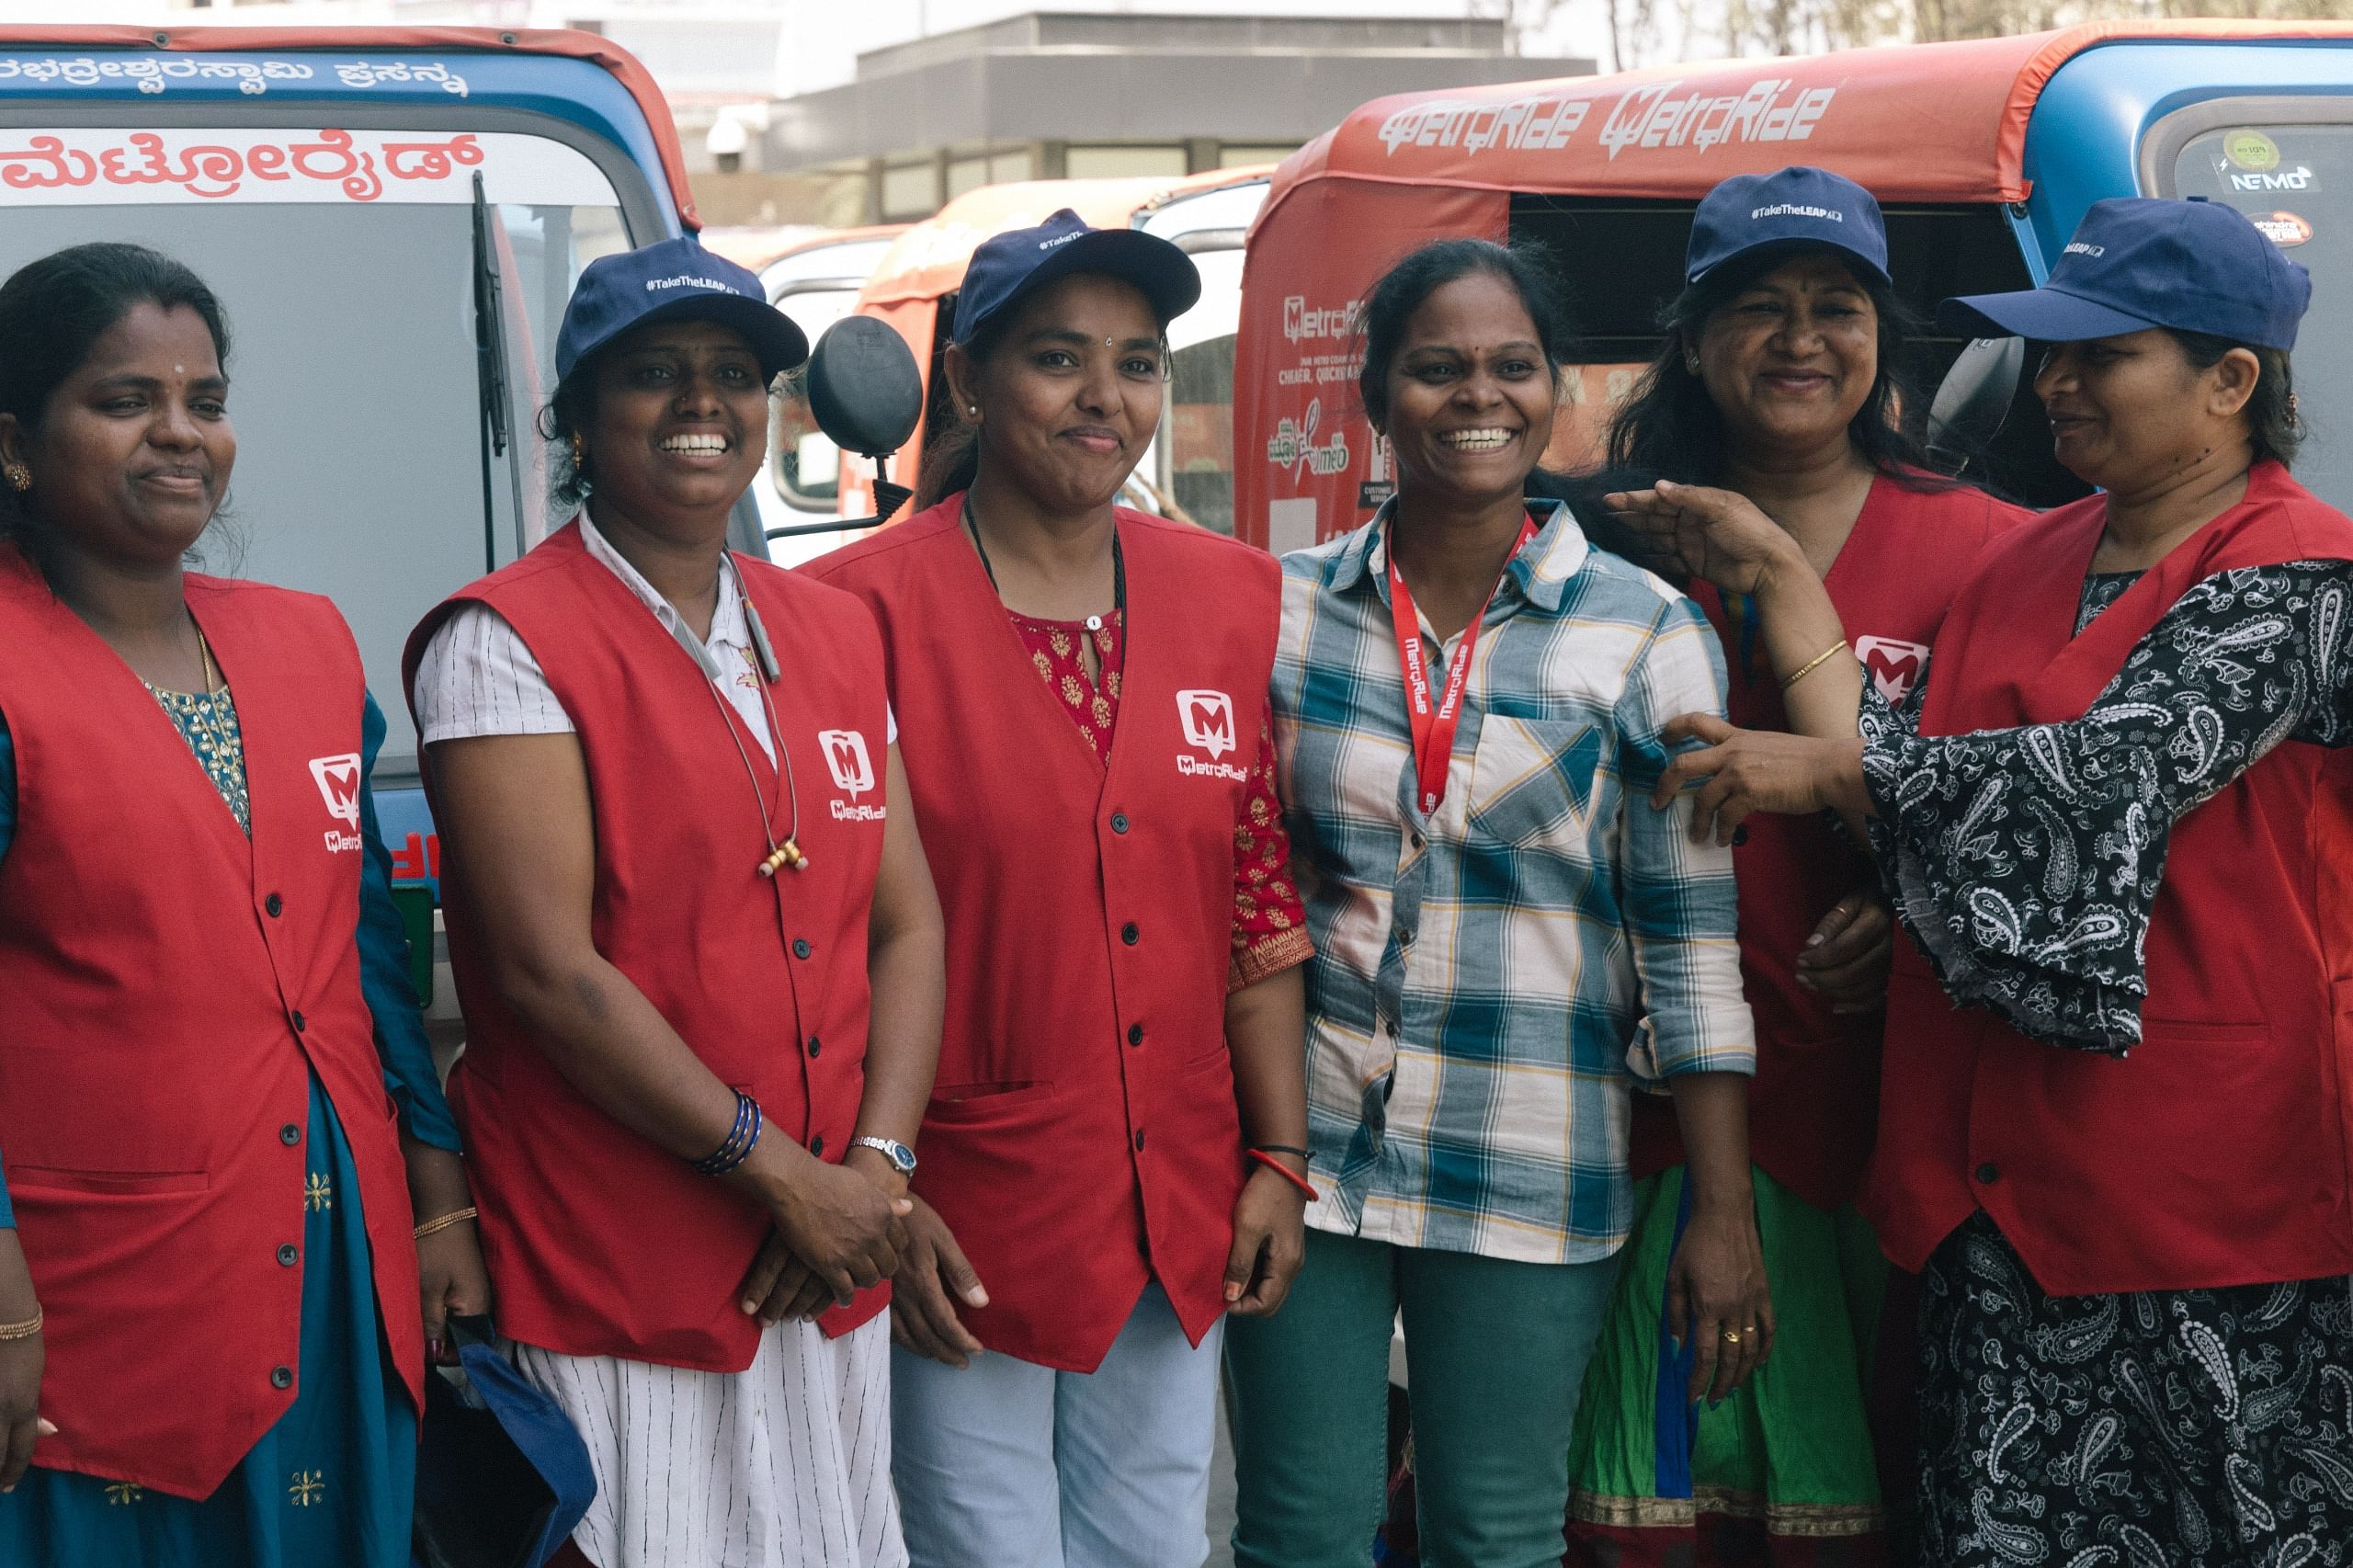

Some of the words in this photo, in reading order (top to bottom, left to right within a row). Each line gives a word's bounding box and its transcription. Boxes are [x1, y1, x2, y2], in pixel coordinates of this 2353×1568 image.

[1598, 79, 1836, 162] MetroRide
[0, 128, 484, 201] ಮೆಟ್ರೋರೈಡ್
[2230, 169, 2311, 191] NEMO
[1751, 204, 1827, 220] #TakeTheLEAP
[1404, 637, 1427, 715] MetroRide
[1438, 644, 1469, 720] MetroRide
[1176, 755, 1248, 783] MetroRide
